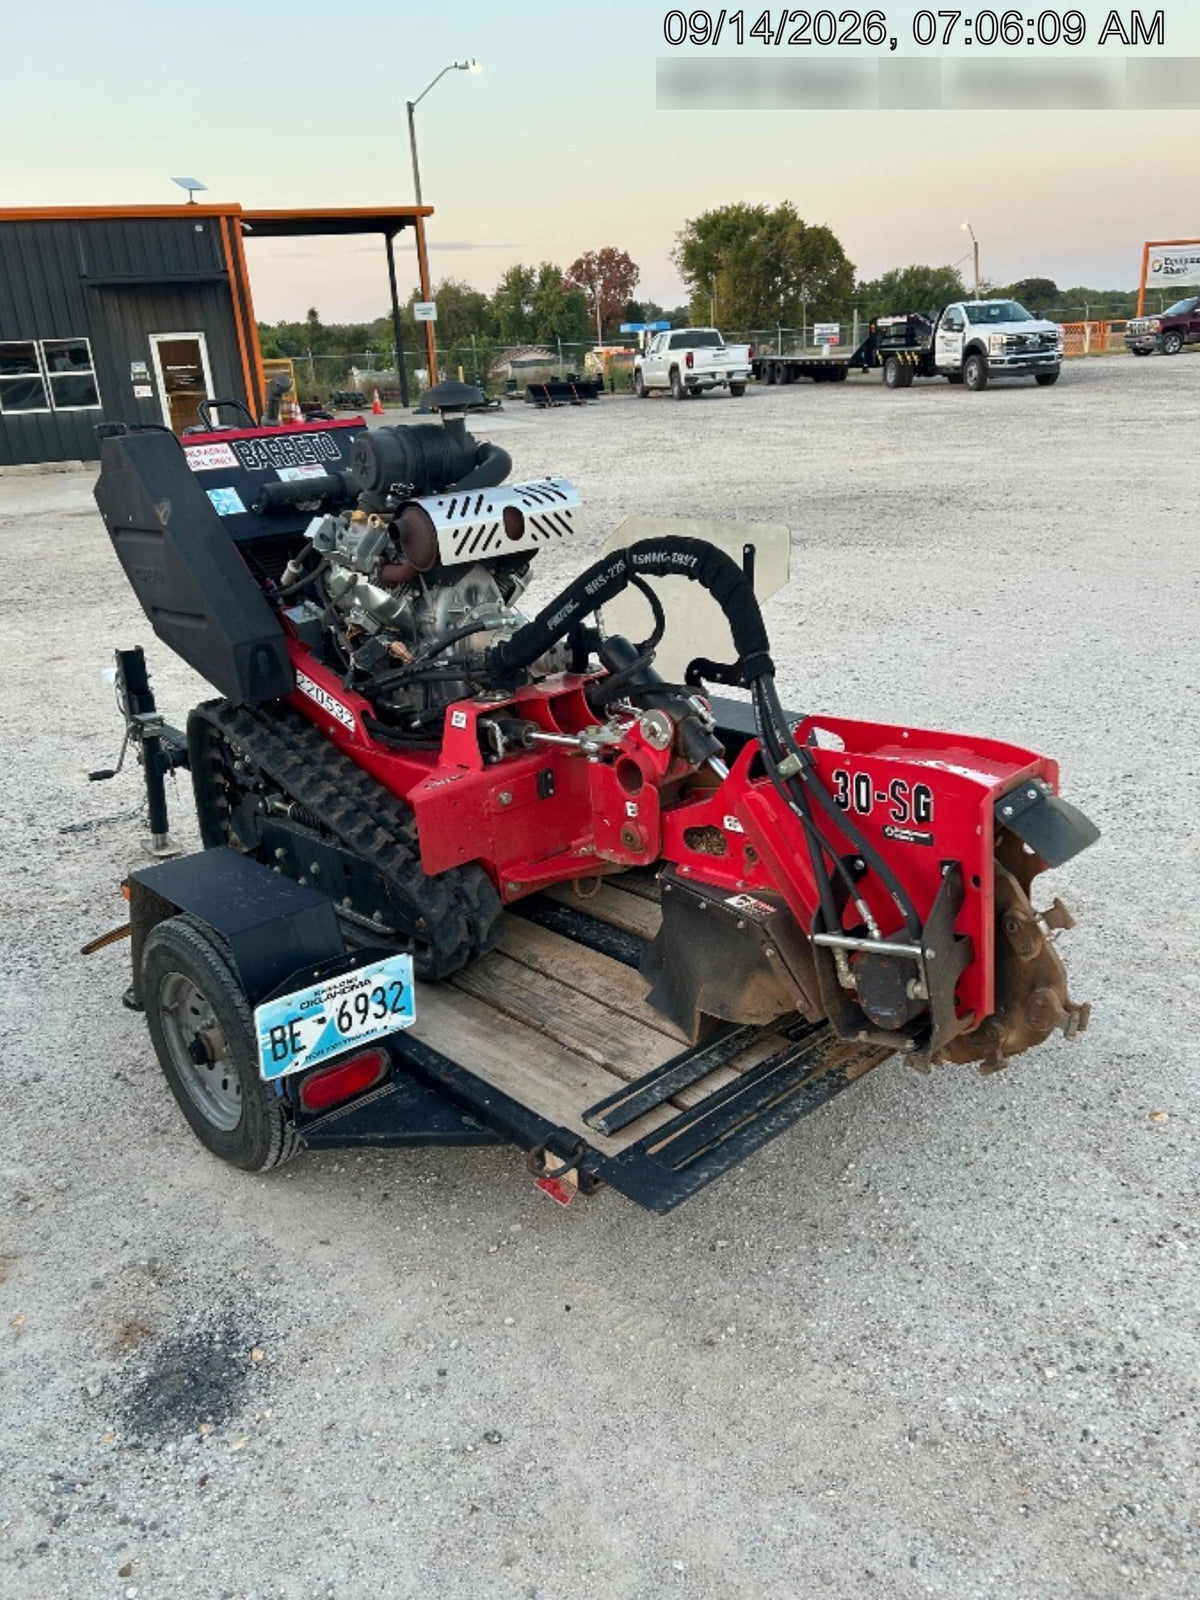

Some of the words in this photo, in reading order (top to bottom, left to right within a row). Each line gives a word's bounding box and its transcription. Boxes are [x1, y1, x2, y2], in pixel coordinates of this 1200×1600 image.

[233, 432, 342, 471] BARRETO
[832, 769, 934, 824] 30-SG
[300, 978, 372, 1011] OKLAHOMA
[269, 1016, 307, 1062] BE
[337, 980, 406, 1034] 6932
